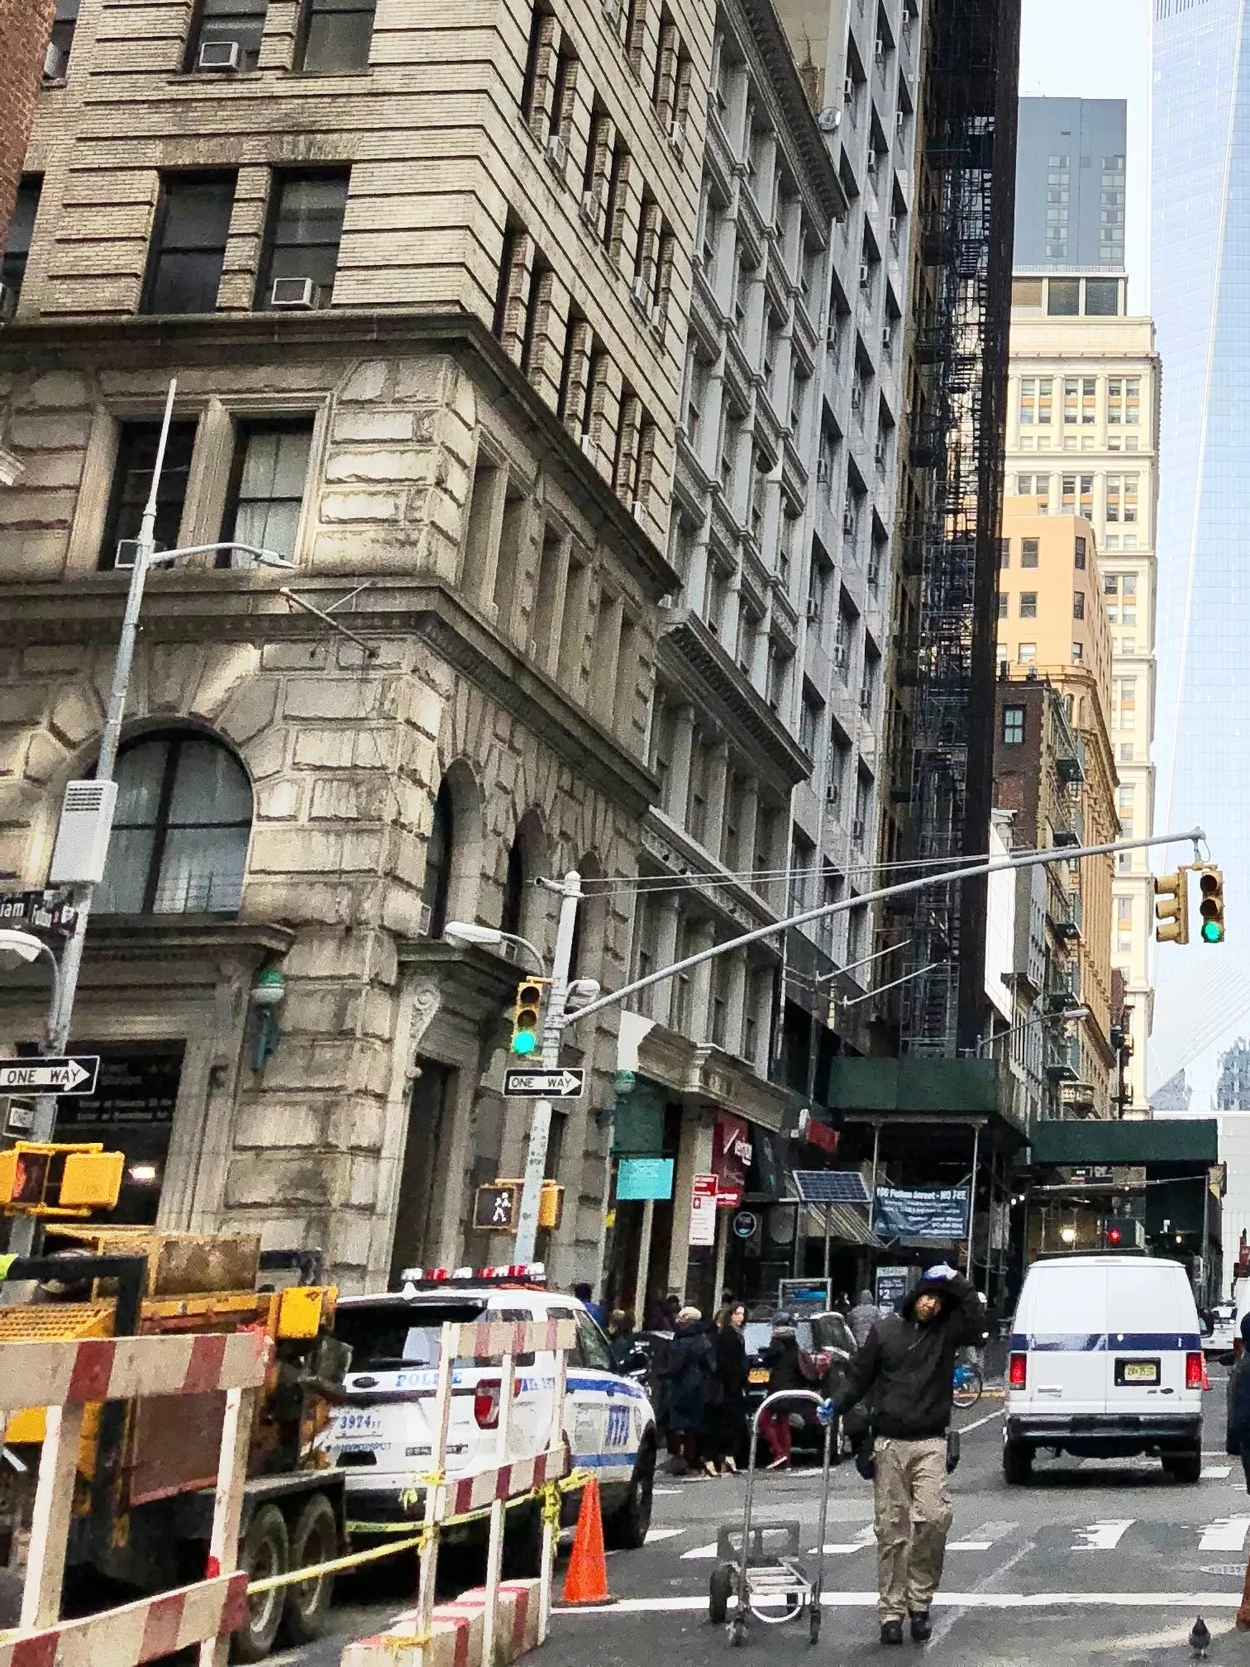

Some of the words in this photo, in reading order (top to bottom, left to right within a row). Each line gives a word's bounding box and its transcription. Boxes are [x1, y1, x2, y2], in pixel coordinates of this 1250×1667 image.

[7, 1069, 37, 1084] ONE
[50, 1068, 81, 1083] WAY
[511, 1077, 535, 1089] ONE
[547, 1077, 573, 1089] WAY
